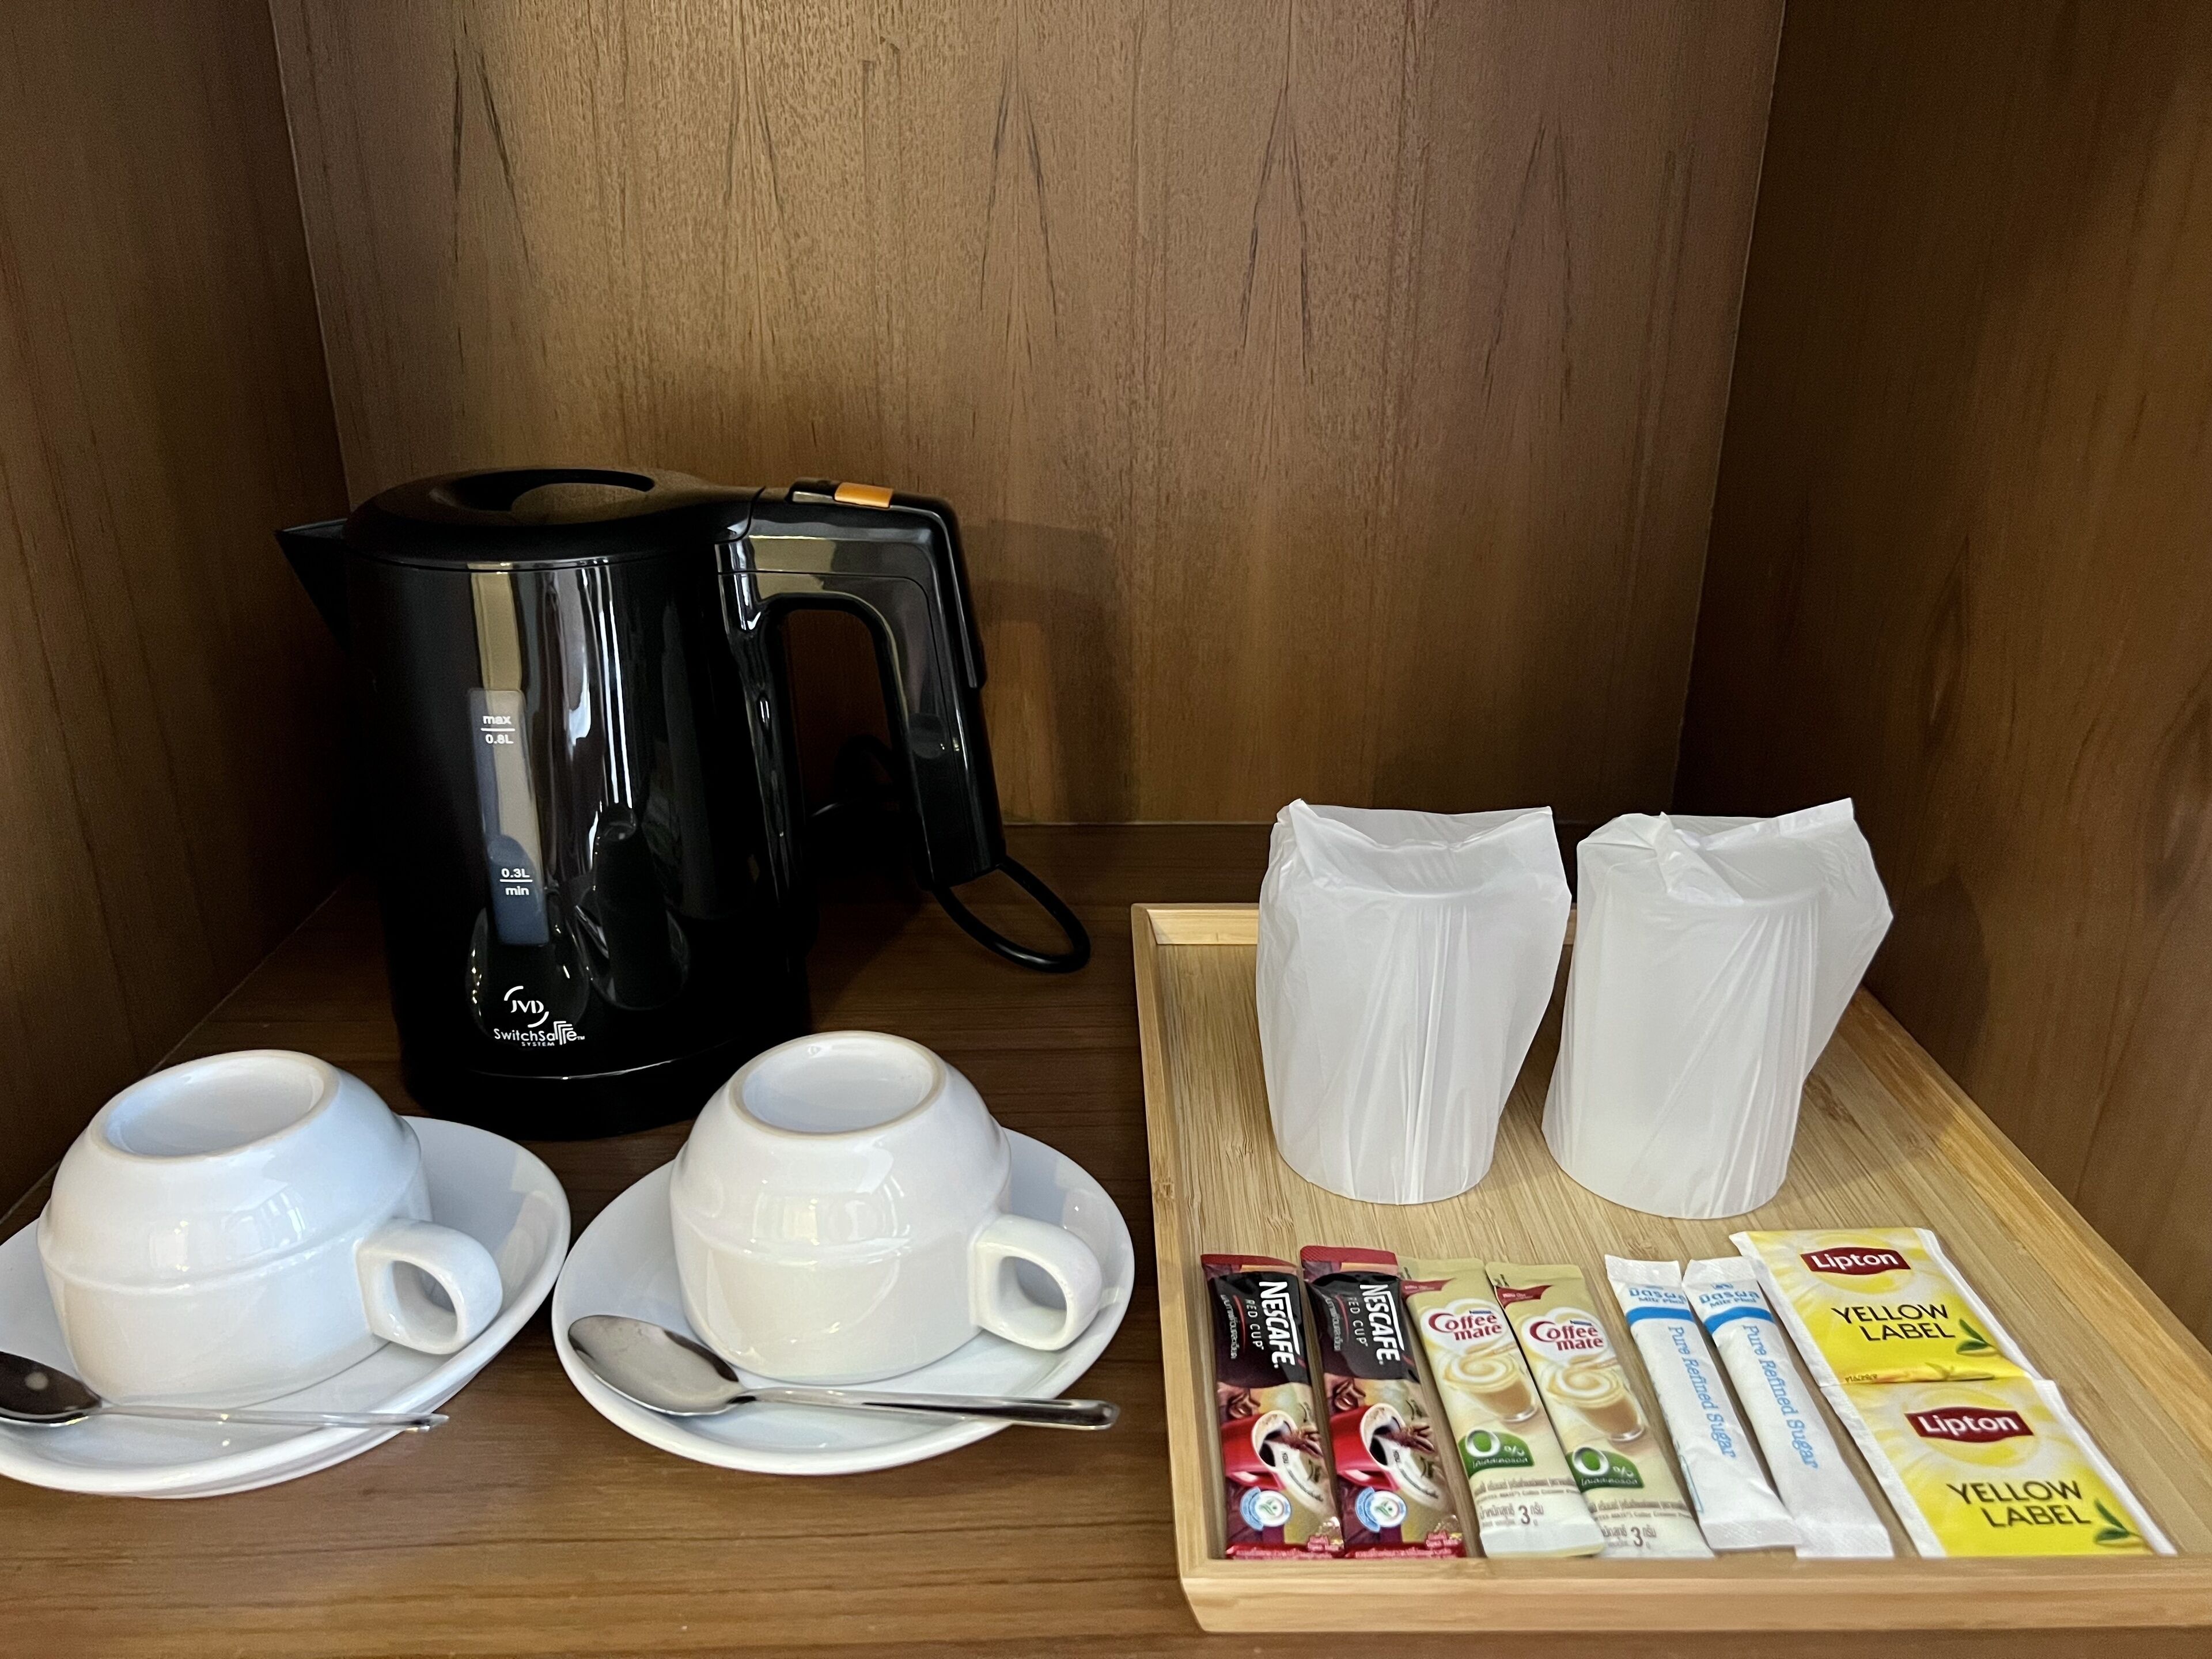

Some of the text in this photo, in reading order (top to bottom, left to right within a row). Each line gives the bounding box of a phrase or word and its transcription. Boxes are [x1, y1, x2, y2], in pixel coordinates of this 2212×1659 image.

[483, 715, 512, 725] max
[485, 734, 514, 744] 0.8L
[501, 868, 530, 878] 0.3L
[505, 885, 529, 896] min
[510, 1000, 544, 1014] JVD
[1811, 1253, 1899, 1270] Lipton
[1428, 1313, 1498, 1333] Coffee
[1831, 1304, 1948, 1324] YELLOW
[1245, 1299, 1264, 1350] RED CUP
[1353, 1320, 1369, 1347] CUP
[1453, 1324, 1502, 1341] mate
[1529, 1321, 1599, 1342] Coffee
[1859, 1323, 1956, 1341] LABEL
[1556, 1338, 1604, 1351] mate
[1668, 1325, 1736, 1459] Pure Refined Sugar
[1742, 1325, 1819, 1469] Pure Refined Sugar
[1917, 1414, 2019, 1436] Lipton
[1946, 1480, 2082, 1505] YELLOW
[1518, 1505, 1531, 1525] 3
[1980, 1505, 2092, 1527] LABEL
[1631, 1527, 1643, 1547] 3
